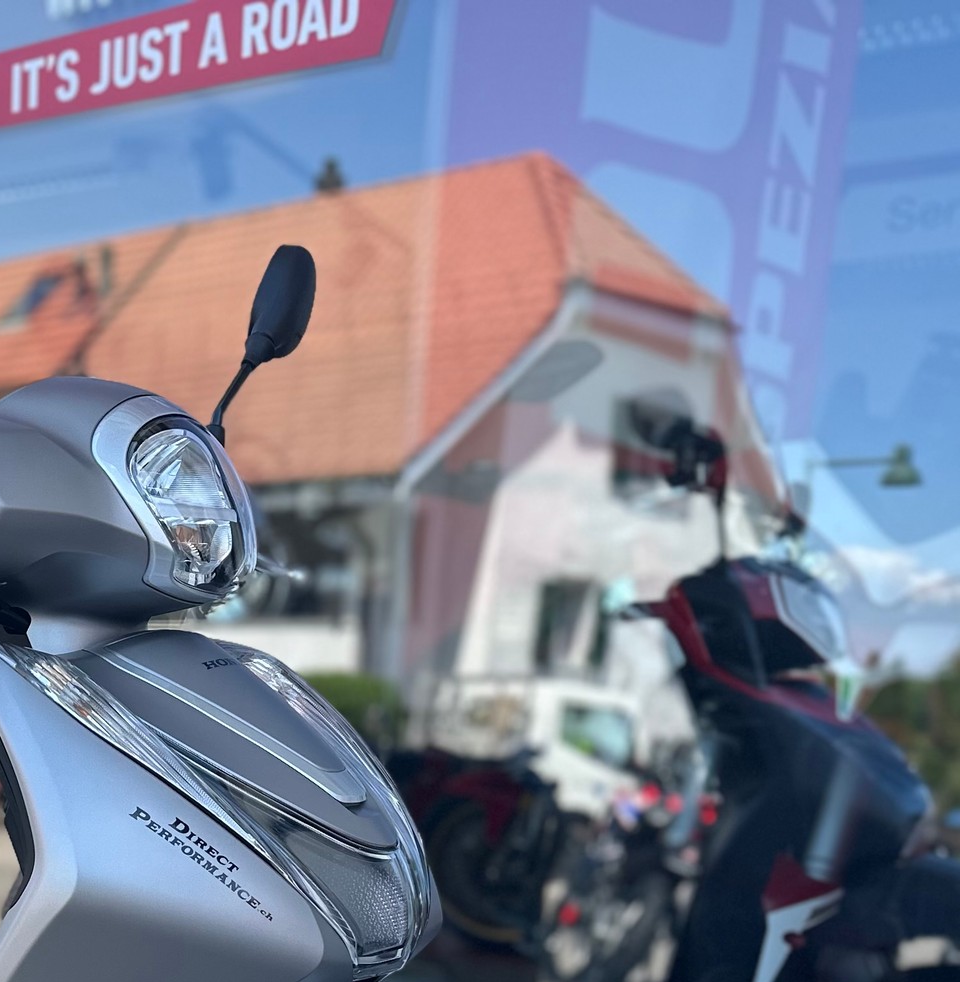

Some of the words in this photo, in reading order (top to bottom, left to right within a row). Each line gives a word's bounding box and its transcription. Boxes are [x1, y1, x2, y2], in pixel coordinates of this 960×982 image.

[10, 51, 80, 114] IT'S
[90, 20, 189, 95] JUST
[198, 12, 228, 69] A
[242, 0, 359, 58] ROAD
[168, 816, 239, 873] DIRECT
